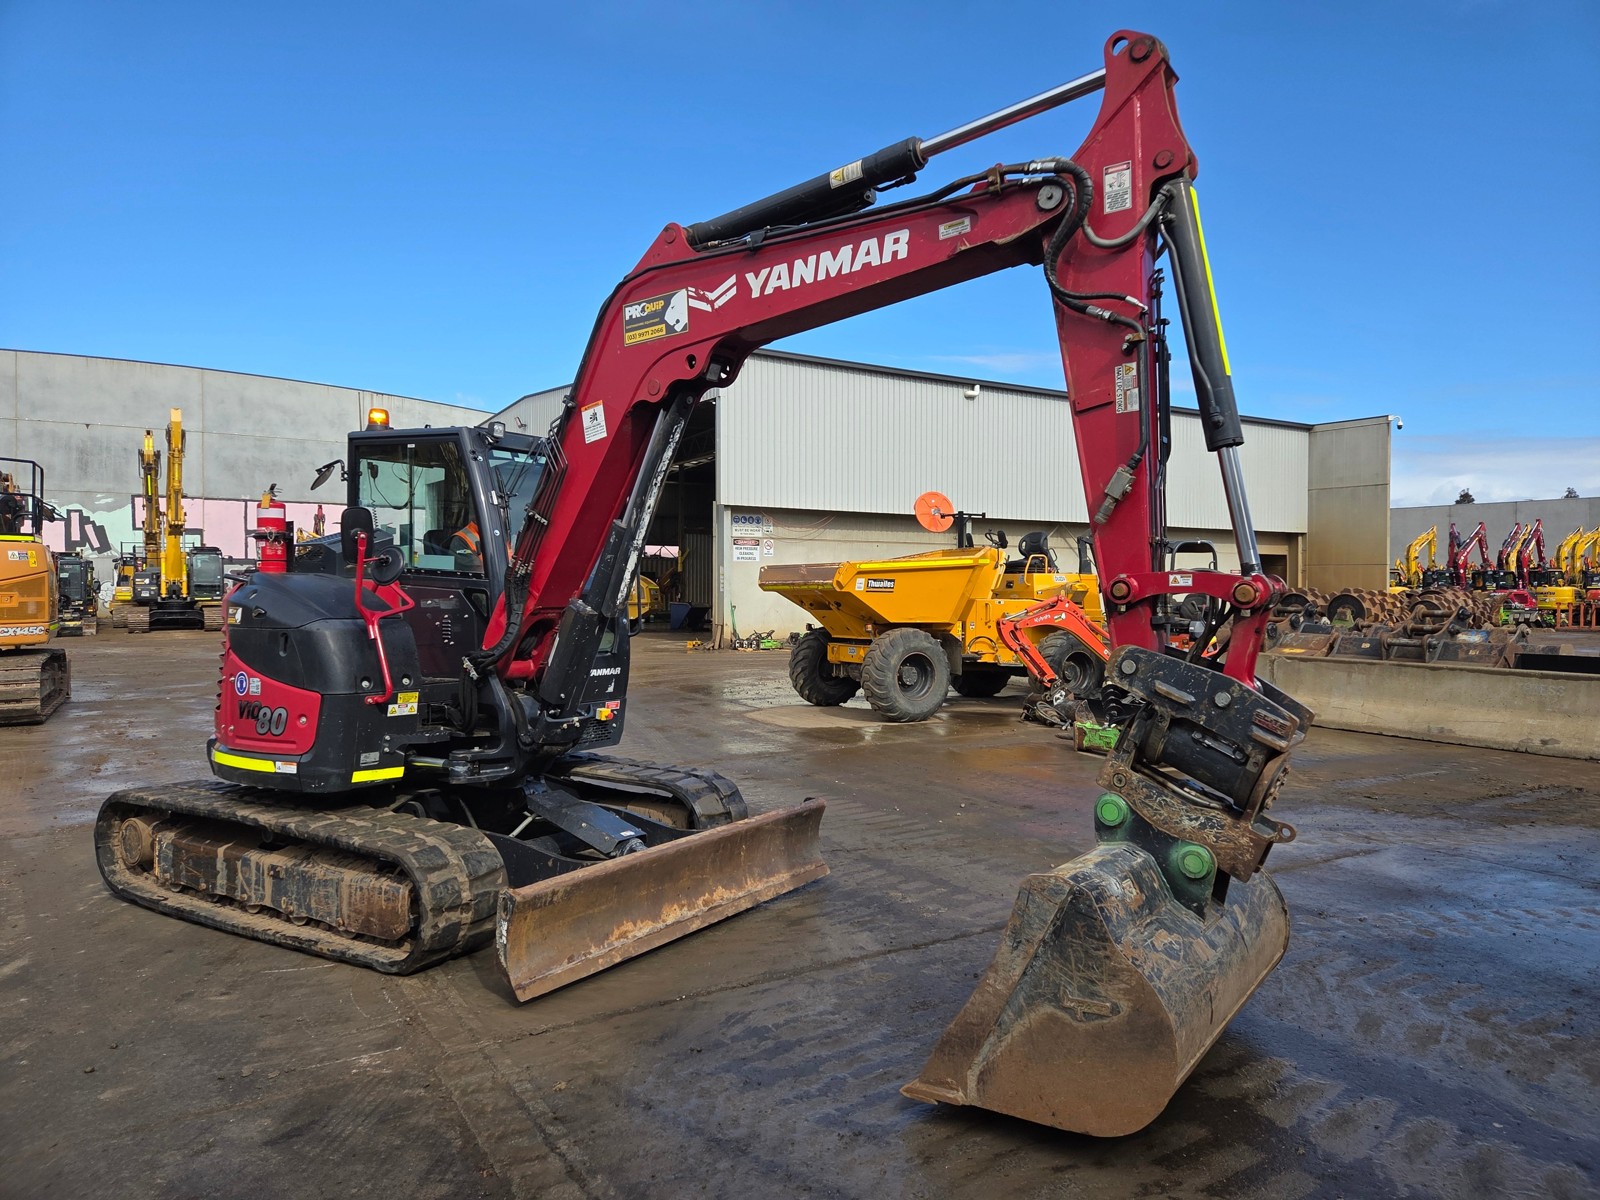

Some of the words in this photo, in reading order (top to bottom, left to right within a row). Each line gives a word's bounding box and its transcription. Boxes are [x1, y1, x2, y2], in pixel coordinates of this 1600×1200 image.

[745, 228, 910, 299] YANMAR
[627, 333, 638, 342] (03)
[650, 327, 664, 335] 2066
[868, 580, 894, 588] Thwaites
[590, 667, 621, 676] ANMAR
